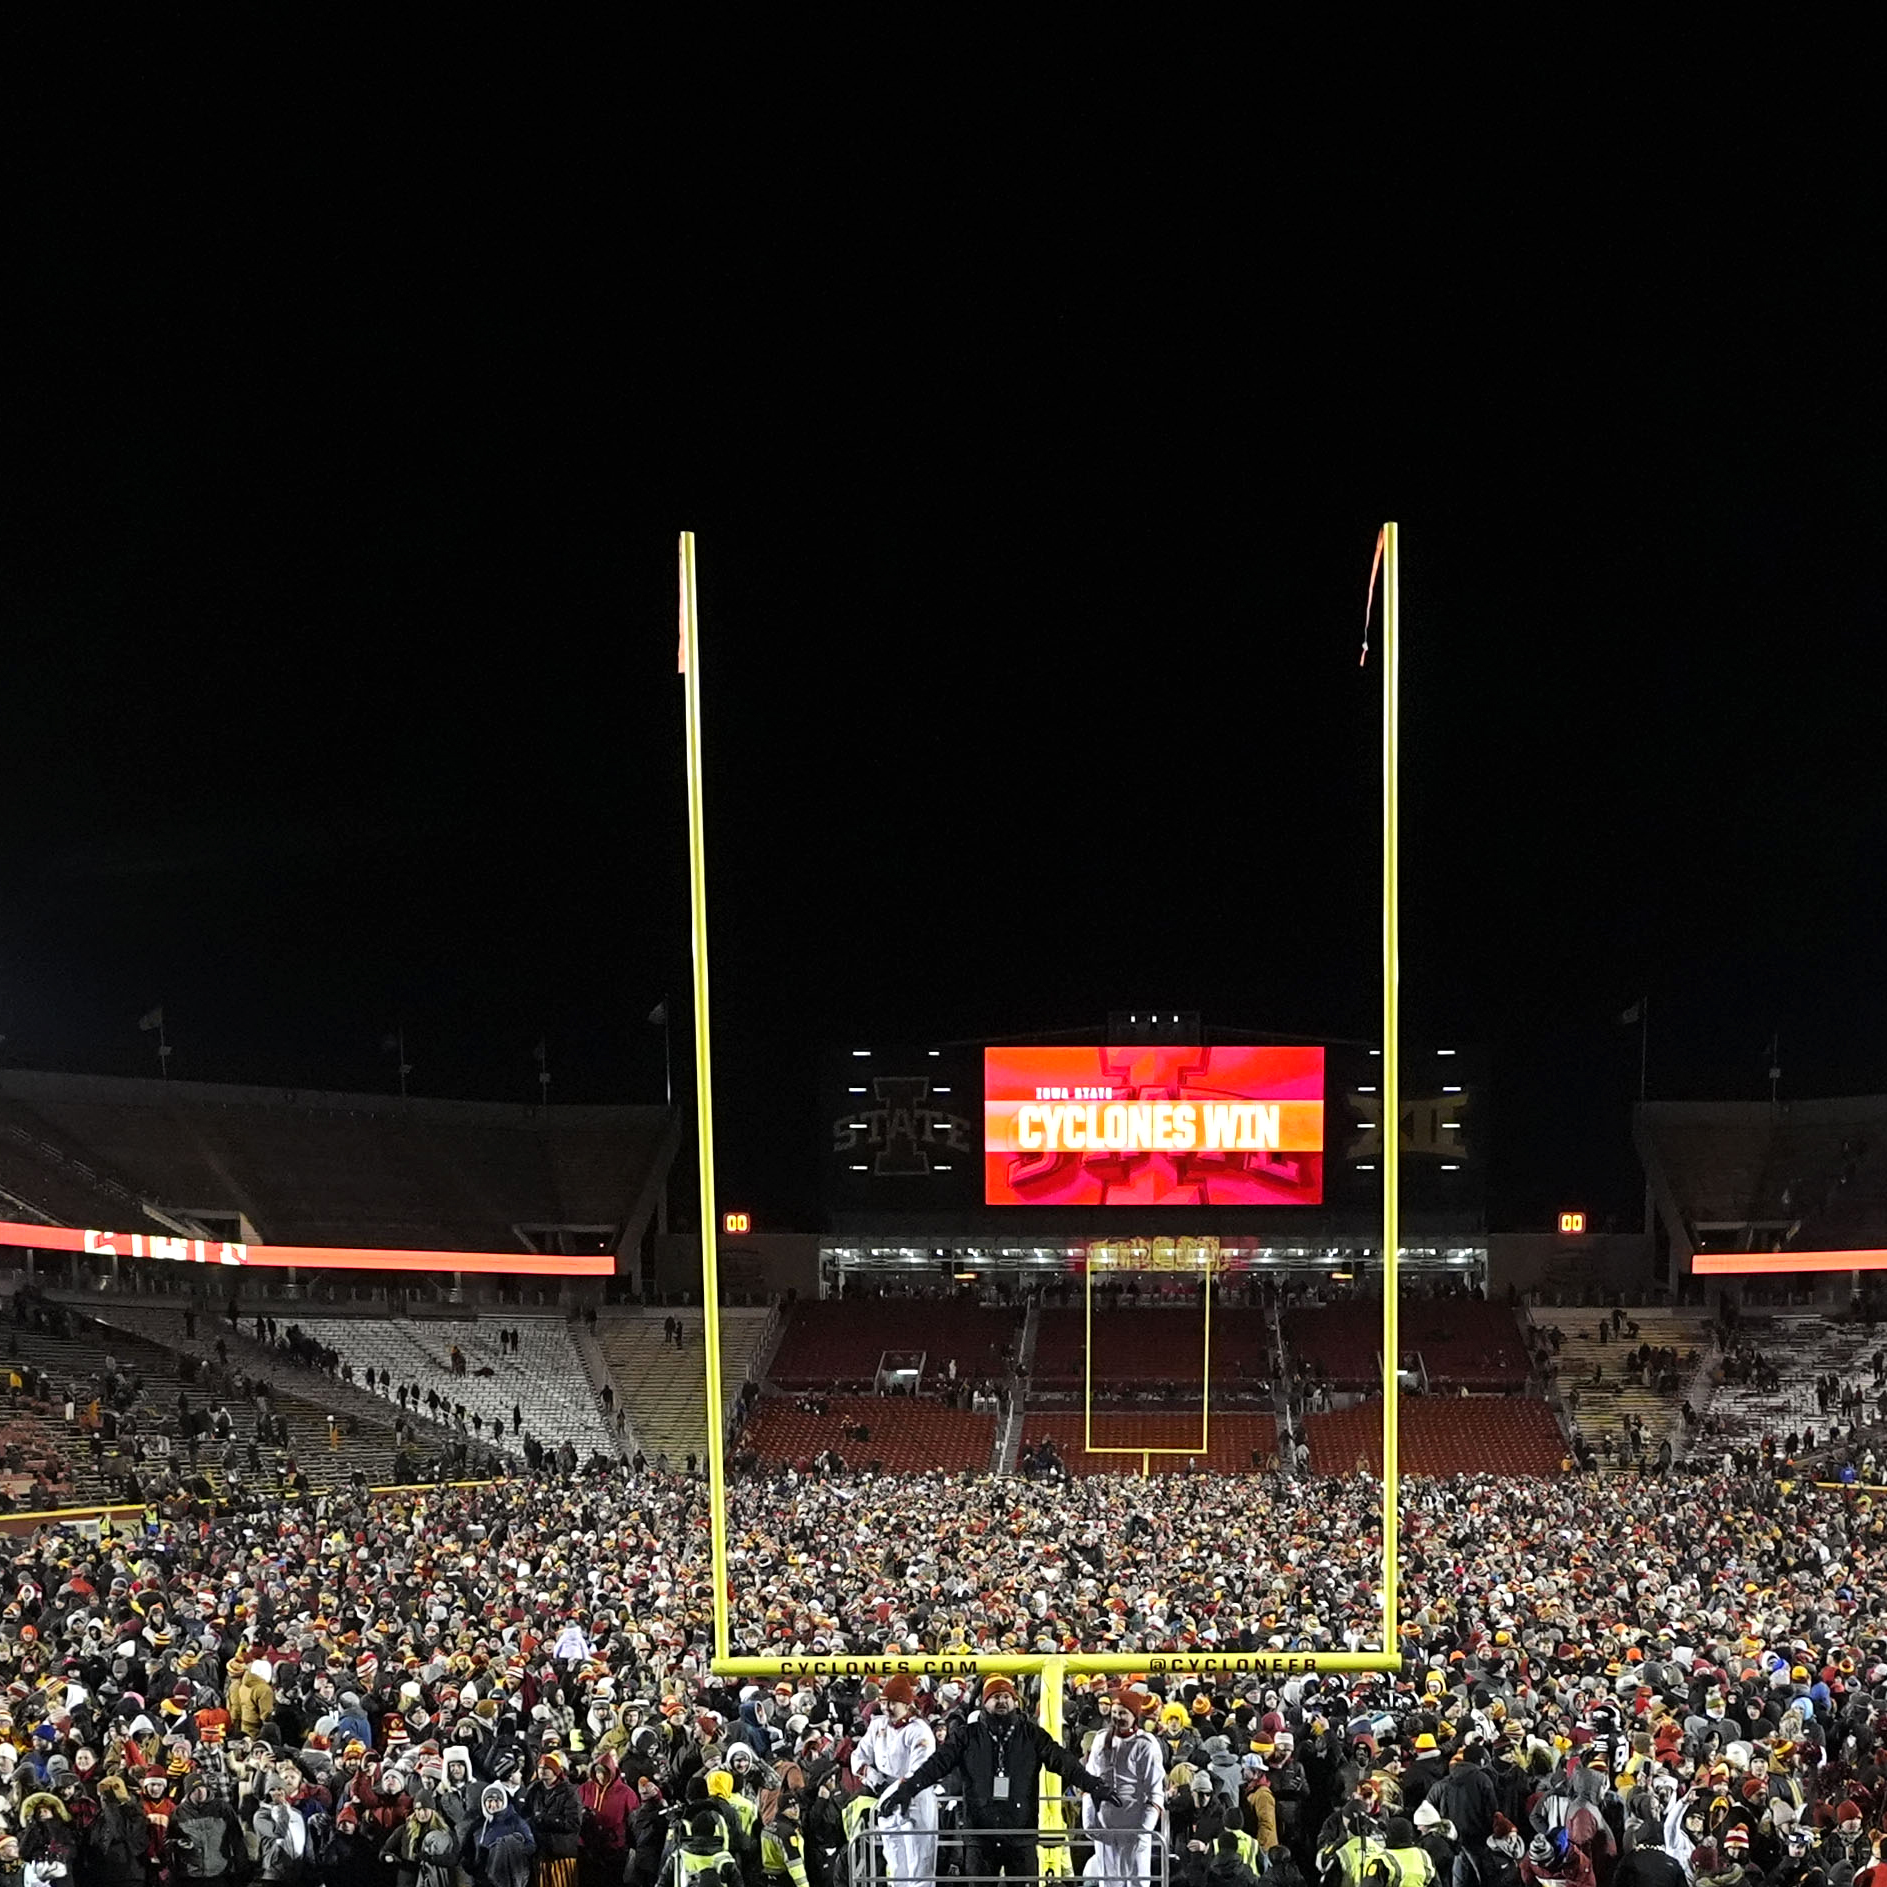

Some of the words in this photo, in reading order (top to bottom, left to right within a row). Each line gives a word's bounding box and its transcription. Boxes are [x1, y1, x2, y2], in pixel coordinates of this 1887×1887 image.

[1035, 1086, 1069, 1100] IOWA
[1018, 1104, 1197, 1149] CYCLONES
[1202, 1104, 1280, 1149] WIN
[726, 1214, 748, 1232] 00
[1561, 1214, 1583, 1232] 00
[1149, 1657, 1317, 1674] @CYCLONEFB
